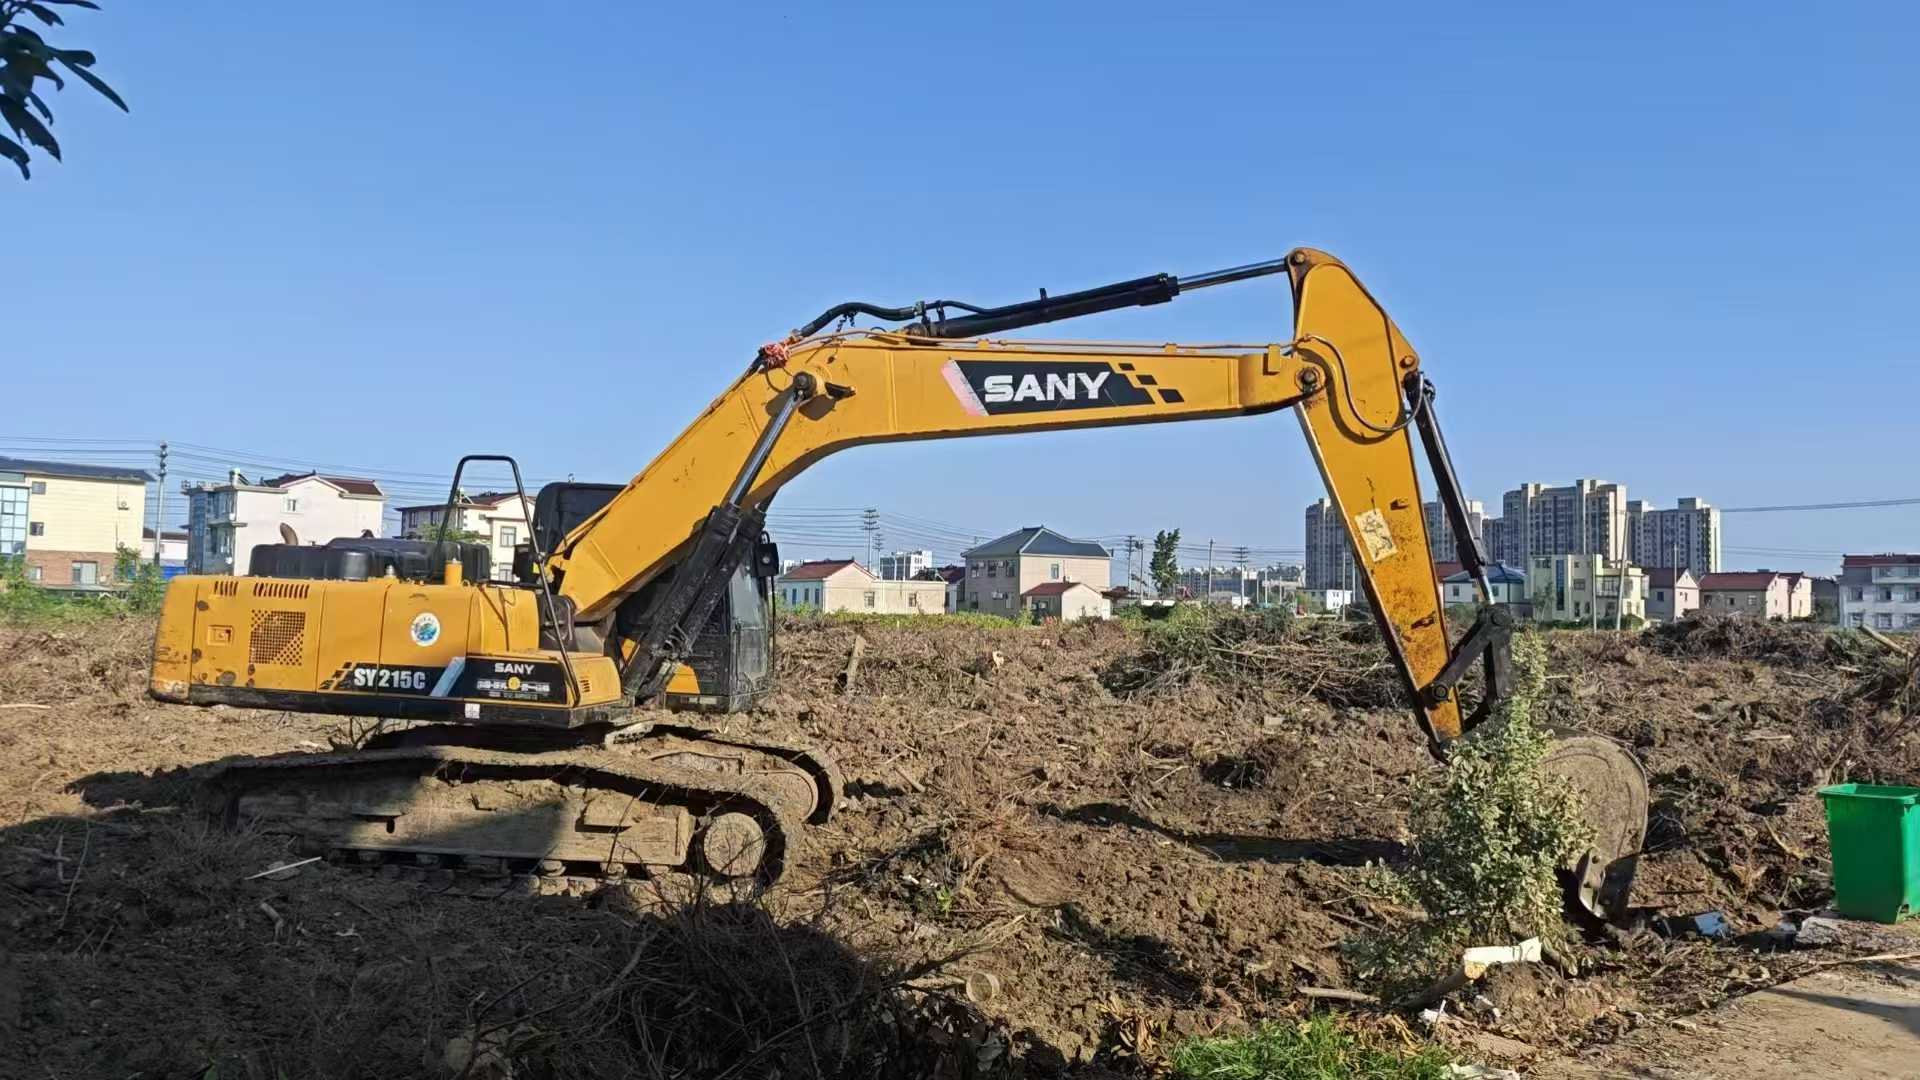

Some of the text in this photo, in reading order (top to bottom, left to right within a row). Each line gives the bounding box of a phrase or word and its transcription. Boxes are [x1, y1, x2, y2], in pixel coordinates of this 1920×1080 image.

[983, 371, 1111, 403] SANY
[353, 667, 426, 690] SY215C
[494, 662, 535, 675] SANY
